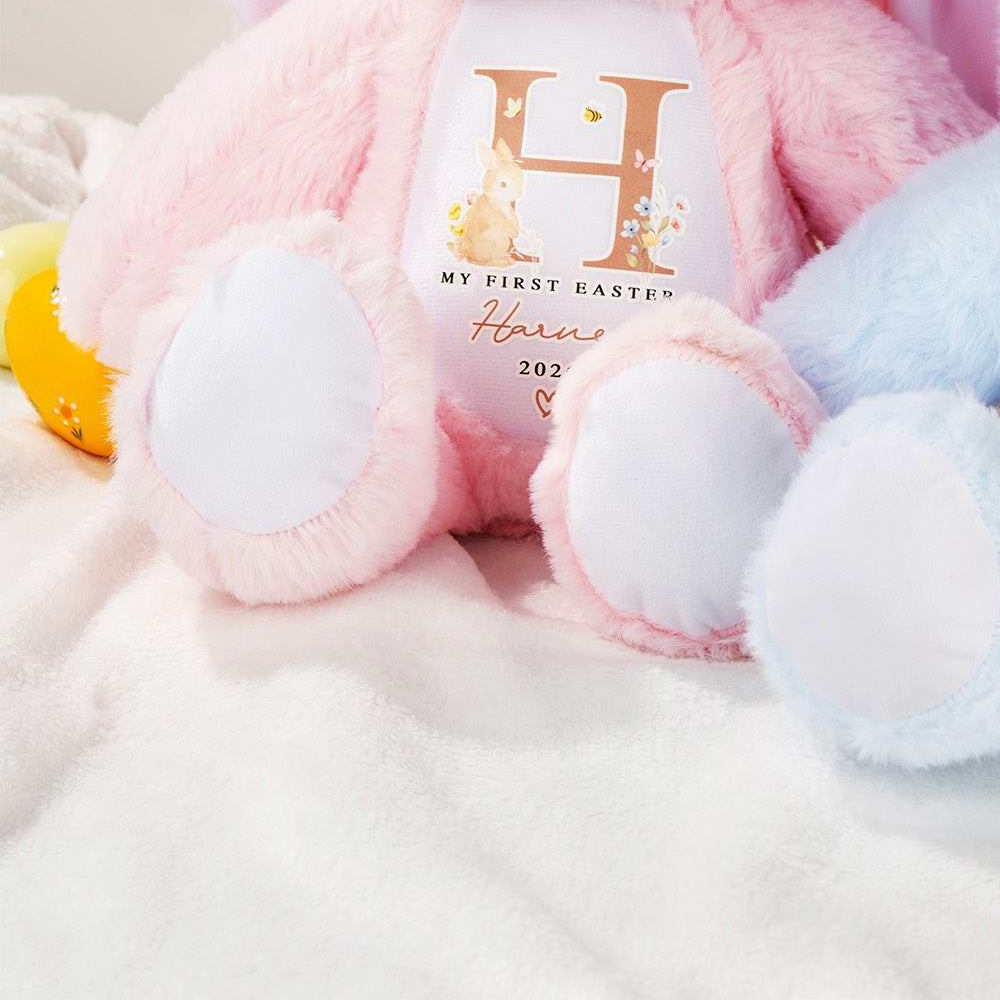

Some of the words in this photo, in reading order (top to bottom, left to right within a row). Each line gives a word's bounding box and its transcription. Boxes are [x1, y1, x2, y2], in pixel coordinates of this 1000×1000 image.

[473, 68, 690, 276] H
[440, 271, 471, 286] MY
[486, 274, 560, 292] FIRST
[471, 298, 606, 343] Harne
[518, 359, 570, 379] 202
